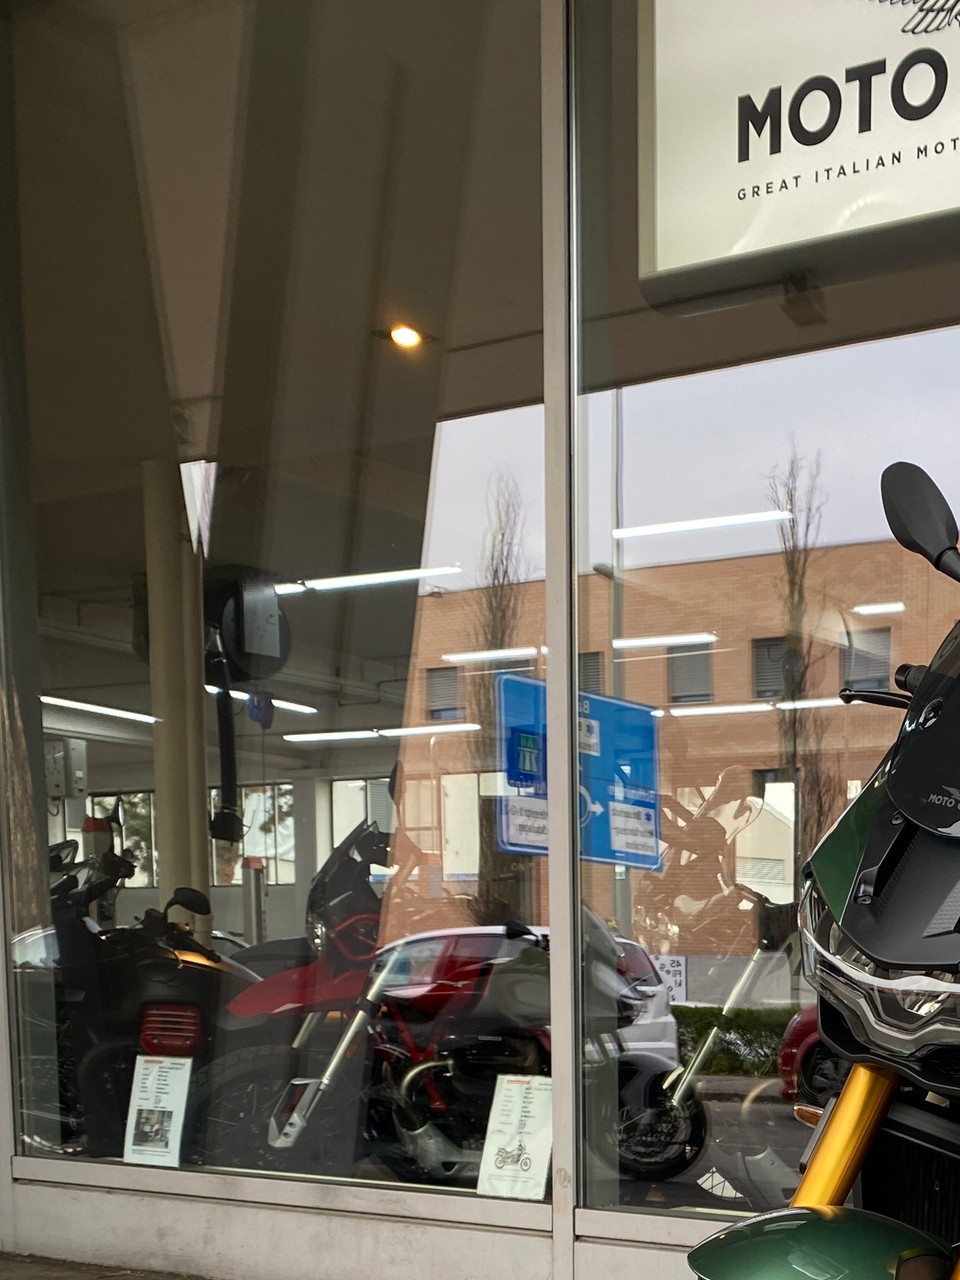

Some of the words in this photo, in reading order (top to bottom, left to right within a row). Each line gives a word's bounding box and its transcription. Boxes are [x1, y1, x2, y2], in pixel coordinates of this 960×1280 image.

[737, 46, 949, 163] MOTO
[737, 174, 801, 201] GREAT
[814, 150, 902, 183] ITALIAN
[928, 793, 955, 808] MOTO
